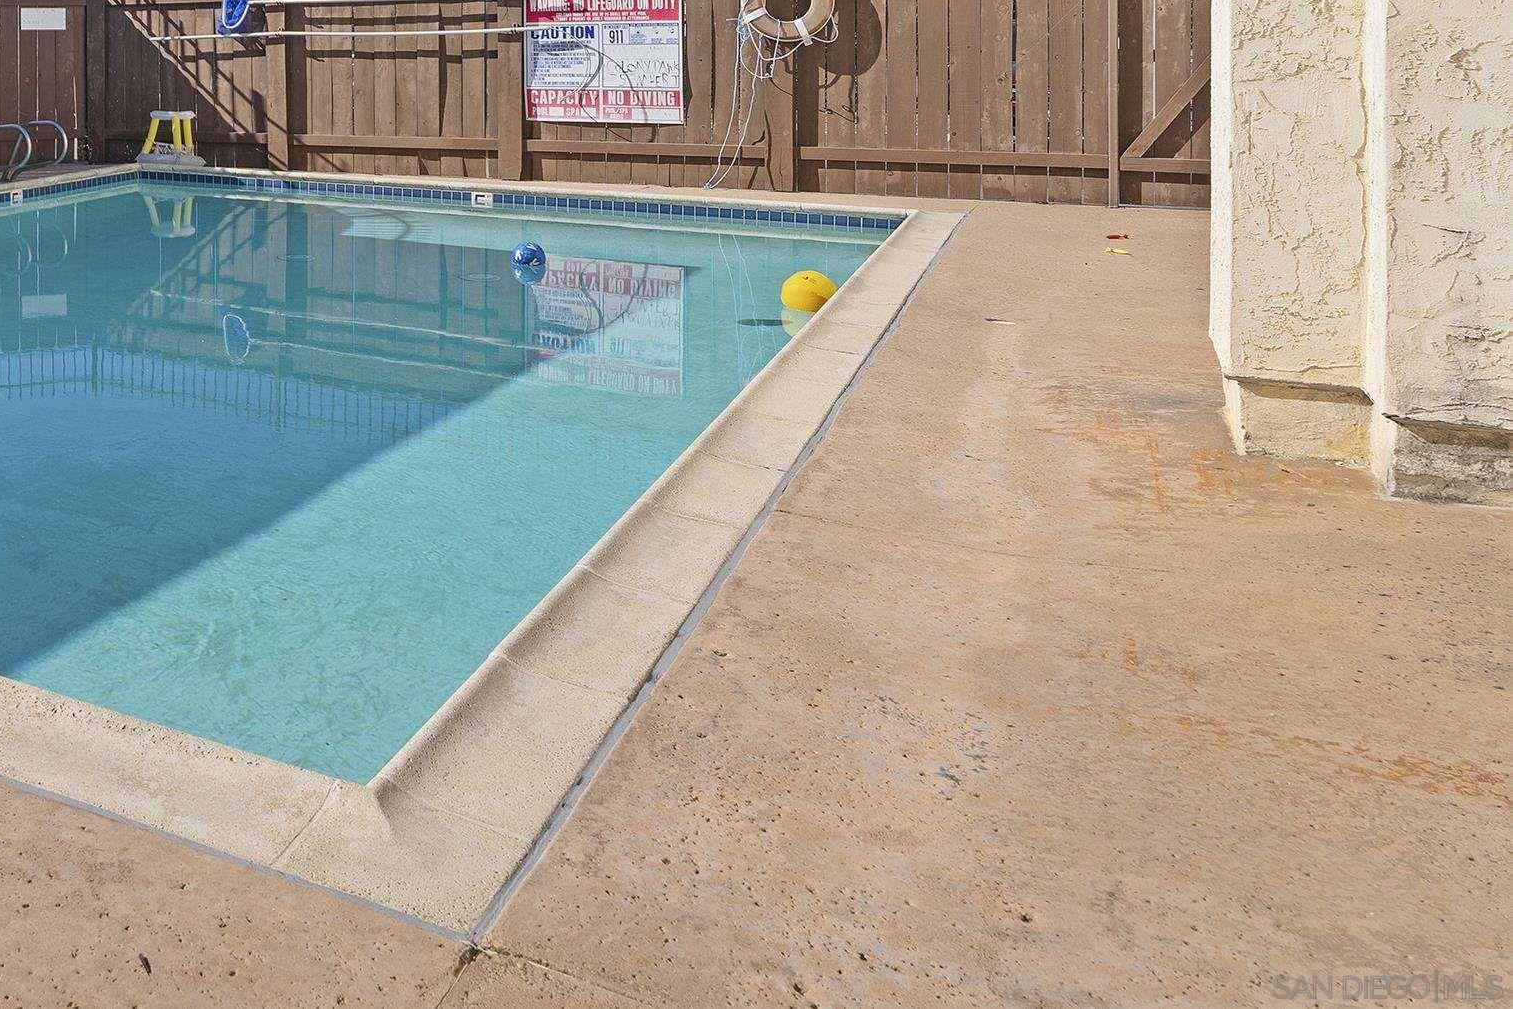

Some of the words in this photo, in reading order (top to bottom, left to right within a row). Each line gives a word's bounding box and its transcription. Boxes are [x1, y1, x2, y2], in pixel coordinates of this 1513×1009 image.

[531, 26, 595, 39] CAUTION
[609, 30, 624, 44] 911
[530, 90, 599, 105] CAPACITY
[608, 91, 625, 105] NO
[630, 91, 675, 106] DIVING
[532, 107, 549, 116] POOL
[566, 107, 582, 116] SPA
